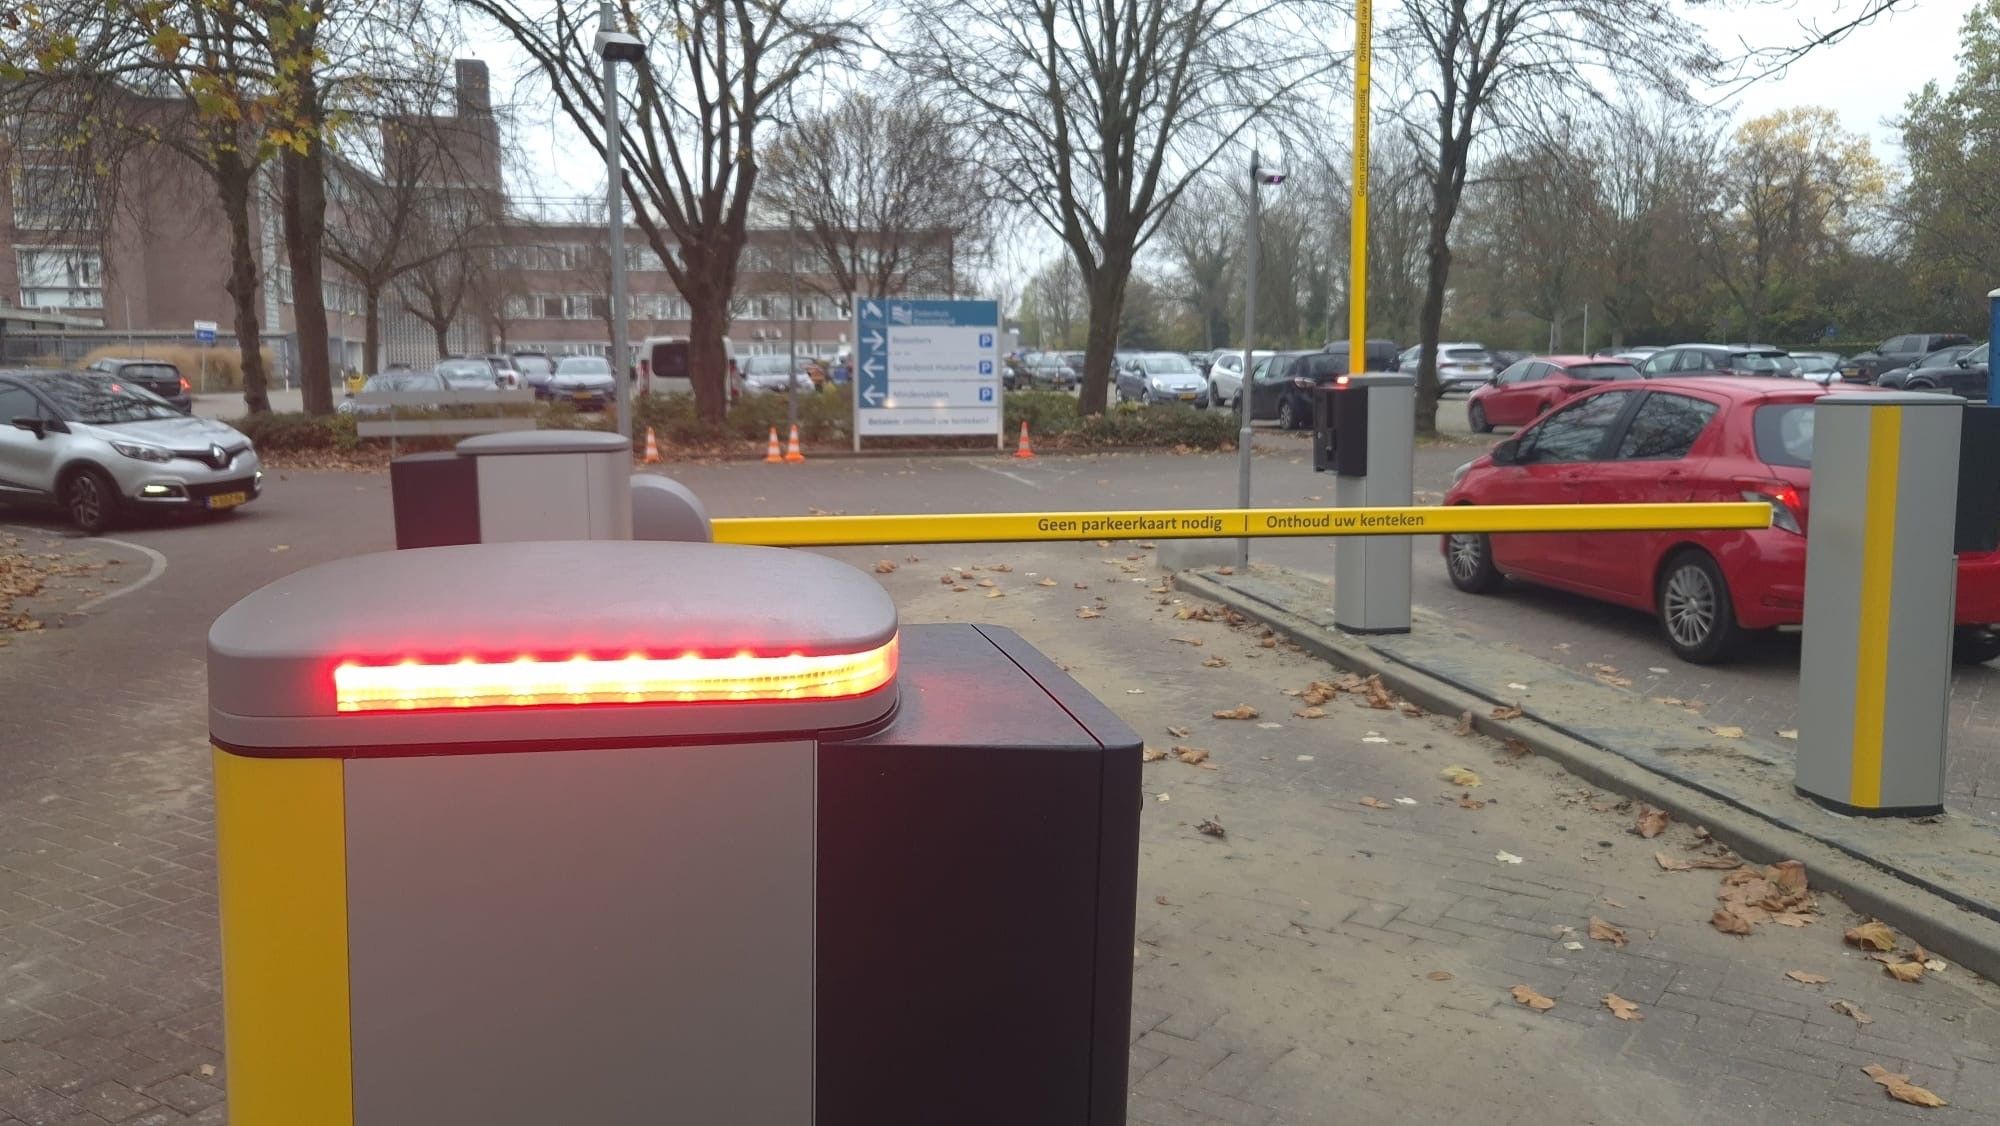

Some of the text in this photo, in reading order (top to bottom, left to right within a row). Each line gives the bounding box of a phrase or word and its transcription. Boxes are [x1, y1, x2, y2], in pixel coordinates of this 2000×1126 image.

[1361, 6, 1368, 20] uw
[1359, 22, 1368, 62] Onthoud
[1358, 88, 1368, 113] nodig
[1357, 116, 1367, 172] parkeerkaart
[1357, 174, 1366, 197] Geen
[1038, 513, 1424, 533] Geen parkeerkaart nodig Onthoud uw kenteken
